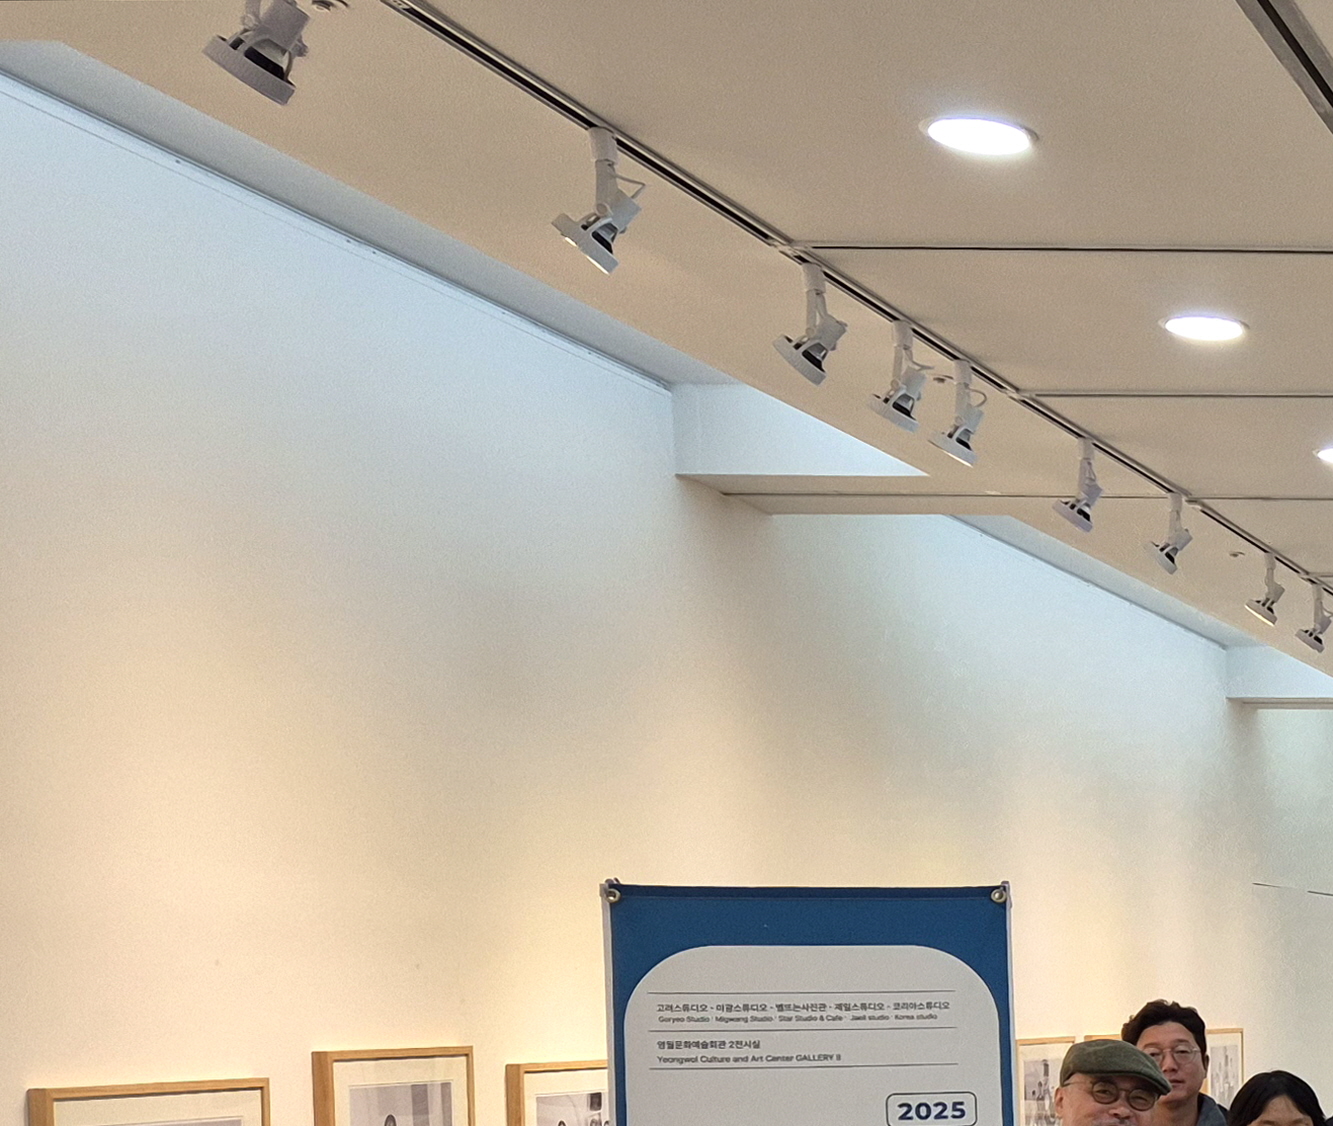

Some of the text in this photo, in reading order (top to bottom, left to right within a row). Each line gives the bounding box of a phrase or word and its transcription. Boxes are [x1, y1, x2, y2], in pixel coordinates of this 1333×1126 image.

[700, 1055, 731, 1063] Culture
[732, 1055, 749, 1063] and
[765, 1054, 794, 1062] Center
[795, 1053, 834, 1062] GALLERY
[897, 1100, 967, 1121] 2025
